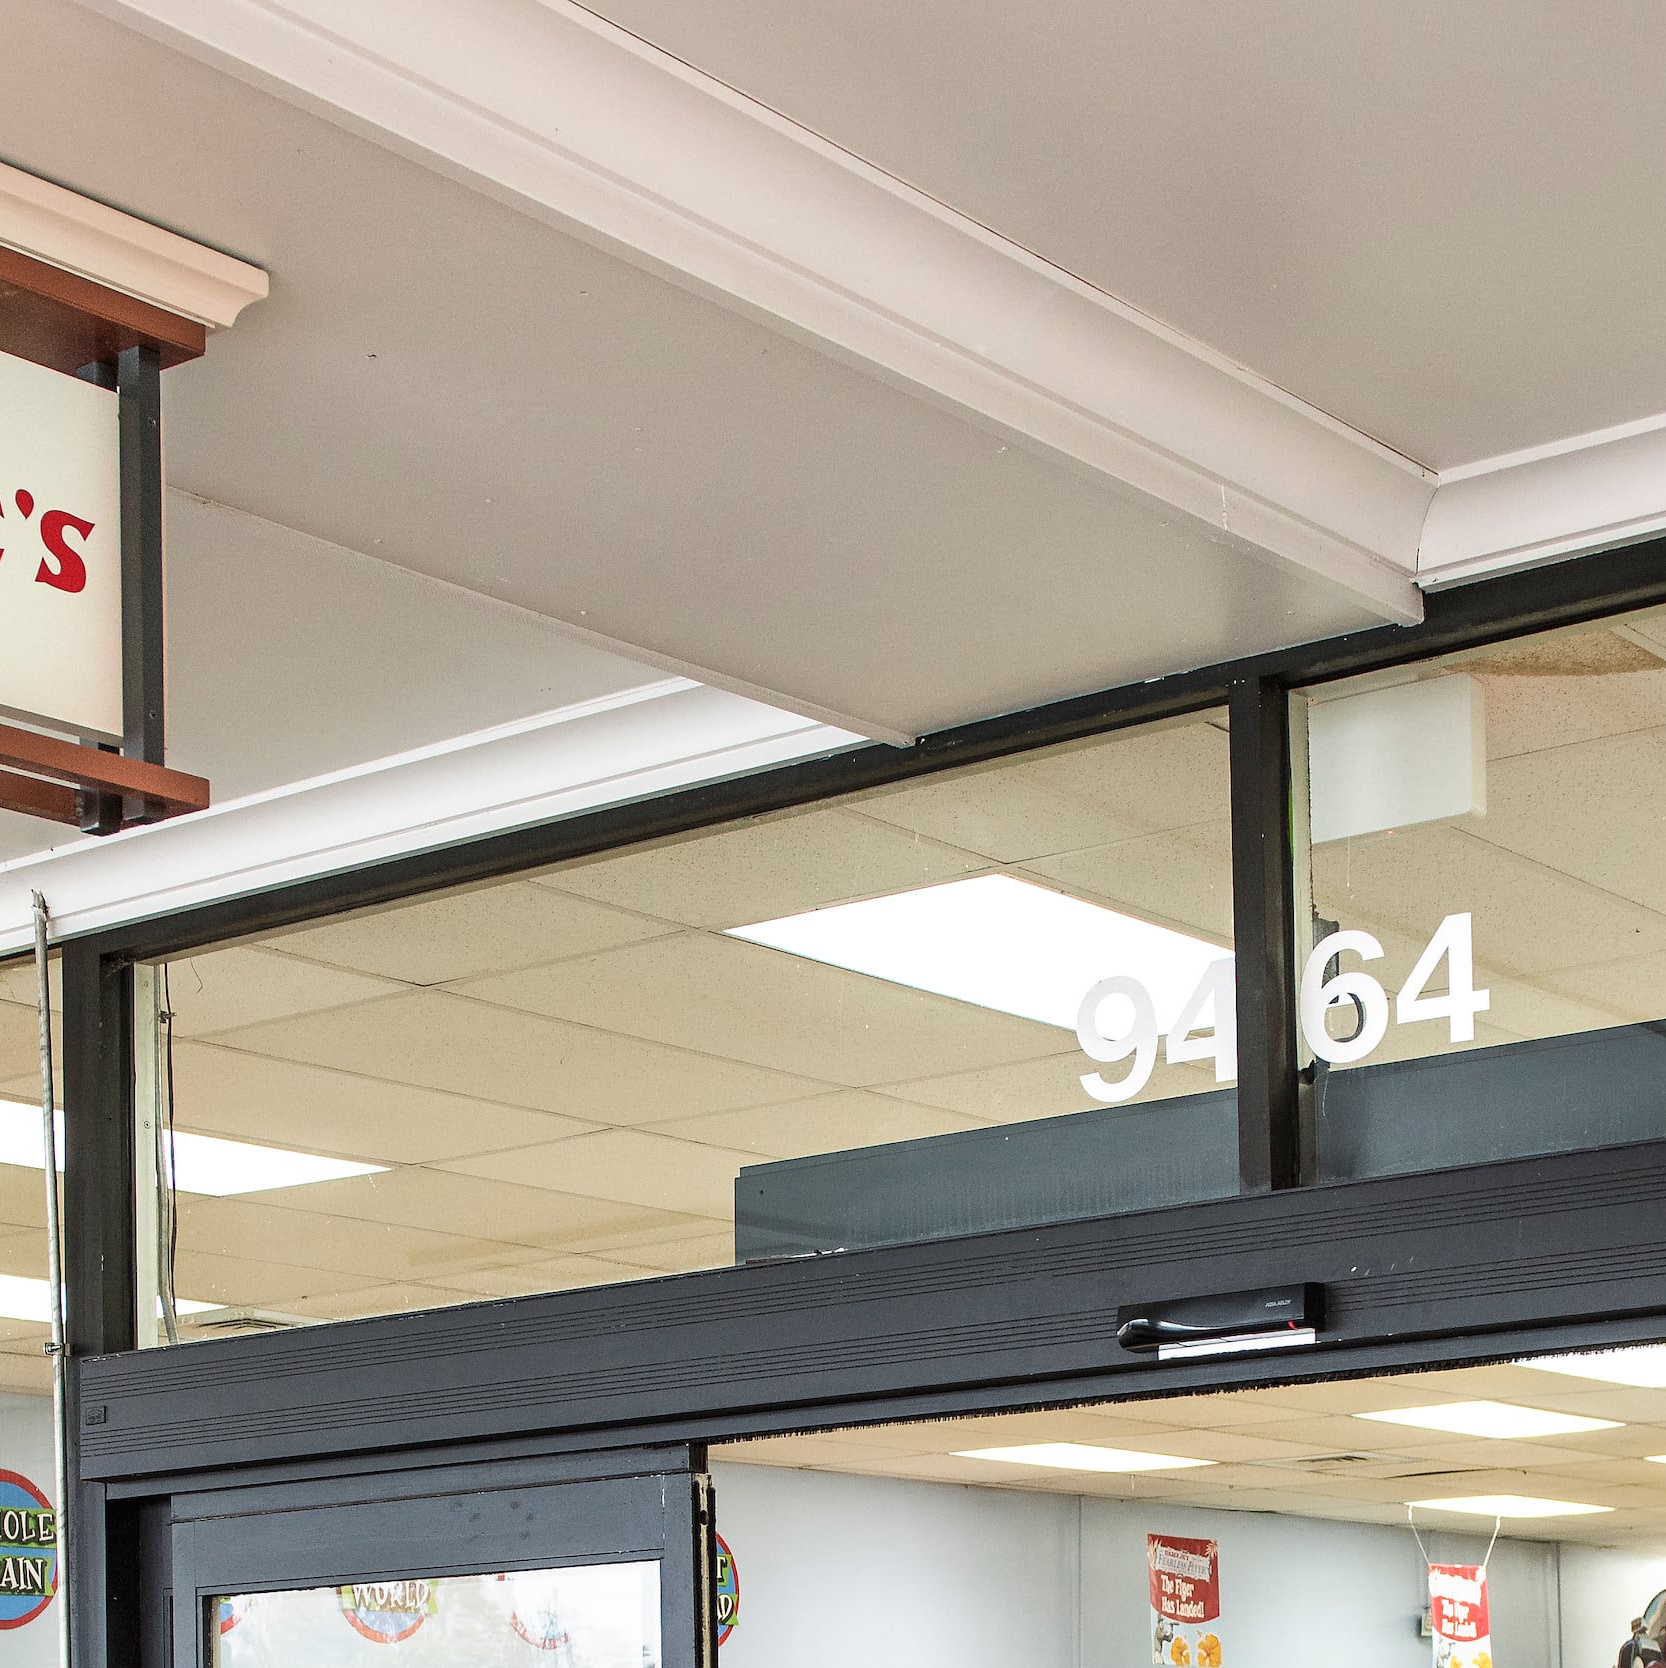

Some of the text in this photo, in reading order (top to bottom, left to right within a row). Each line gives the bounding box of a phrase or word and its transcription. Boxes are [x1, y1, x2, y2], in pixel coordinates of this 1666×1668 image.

[352, 1582, 430, 1609] WORLD
[1161, 1575, 1194, 1601] The Flyer
[1161, 1596, 1205, 1618] Has Landed!
